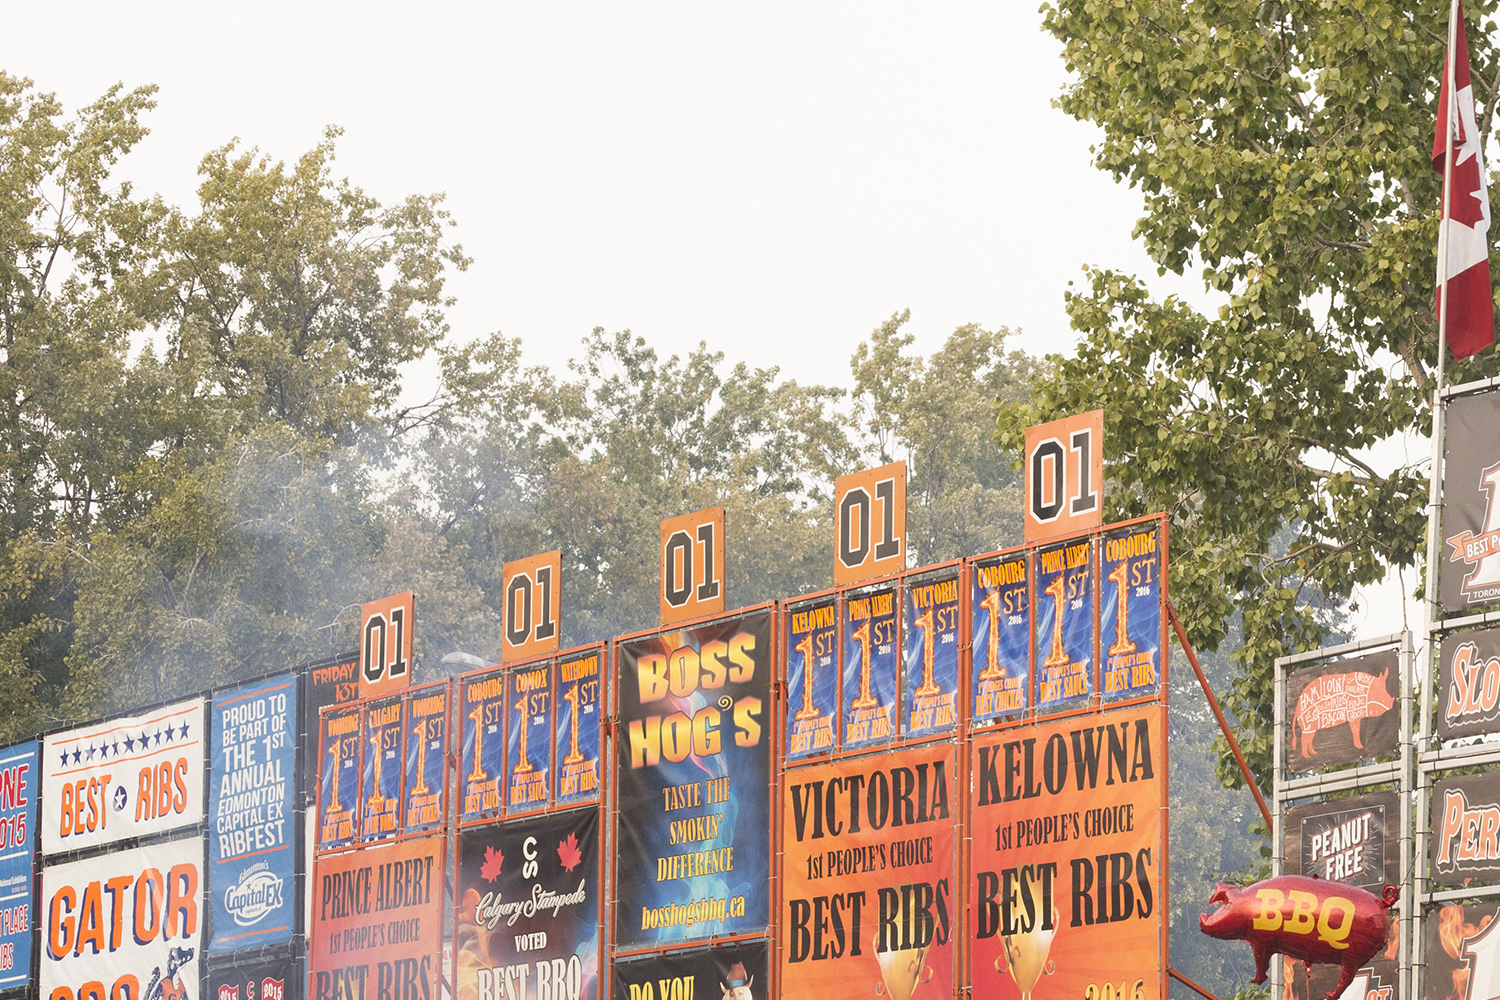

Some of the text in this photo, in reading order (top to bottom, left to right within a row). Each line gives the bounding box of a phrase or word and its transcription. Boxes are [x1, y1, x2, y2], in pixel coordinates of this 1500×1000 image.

[1029, 427, 1098, 524] 01
[839, 477, 901, 569] 01
[1106, 530, 1156, 563] COBOURG
[664, 522, 720, 608] 01
[506, 565, 555, 647] 01
[912, 580, 958, 609] VICTORIA
[362, 605, 407, 685] 01
[637, 632, 756, 704] BOSS
[222, 693, 286, 728] PROUD TO
[1300, 688, 1320, 708] HAM
[1322, 677, 1344, 699] LOIN
[1321, 710, 1346, 728] BACON
[223, 732, 285, 772] THE 1ST
[977, 718, 1154, 807] KELOWNA
[60, 757, 188, 838] BEST RIBS
[220, 759, 285, 798] ANNUAL
[790, 760, 949, 842] VICTORIA
[219, 820, 285, 858] RIBFEST
[996, 804, 1134, 851] 1st PEOPLE'S CHOICE
[1312, 813, 1374, 862] PEANUT
[807, 836, 933, 880] 1st PEOPLE'S CHOICE
[1326, 846, 1364, 881] FREE
[47, 862, 198, 961] GATOR
[641, 895, 745, 930] bosshogsbbq.ca
[977, 847, 1153, 940] BEST RIBS
[789, 878, 949, 964] BEST RIBS
[1253, 889, 1356, 950] BBQ
